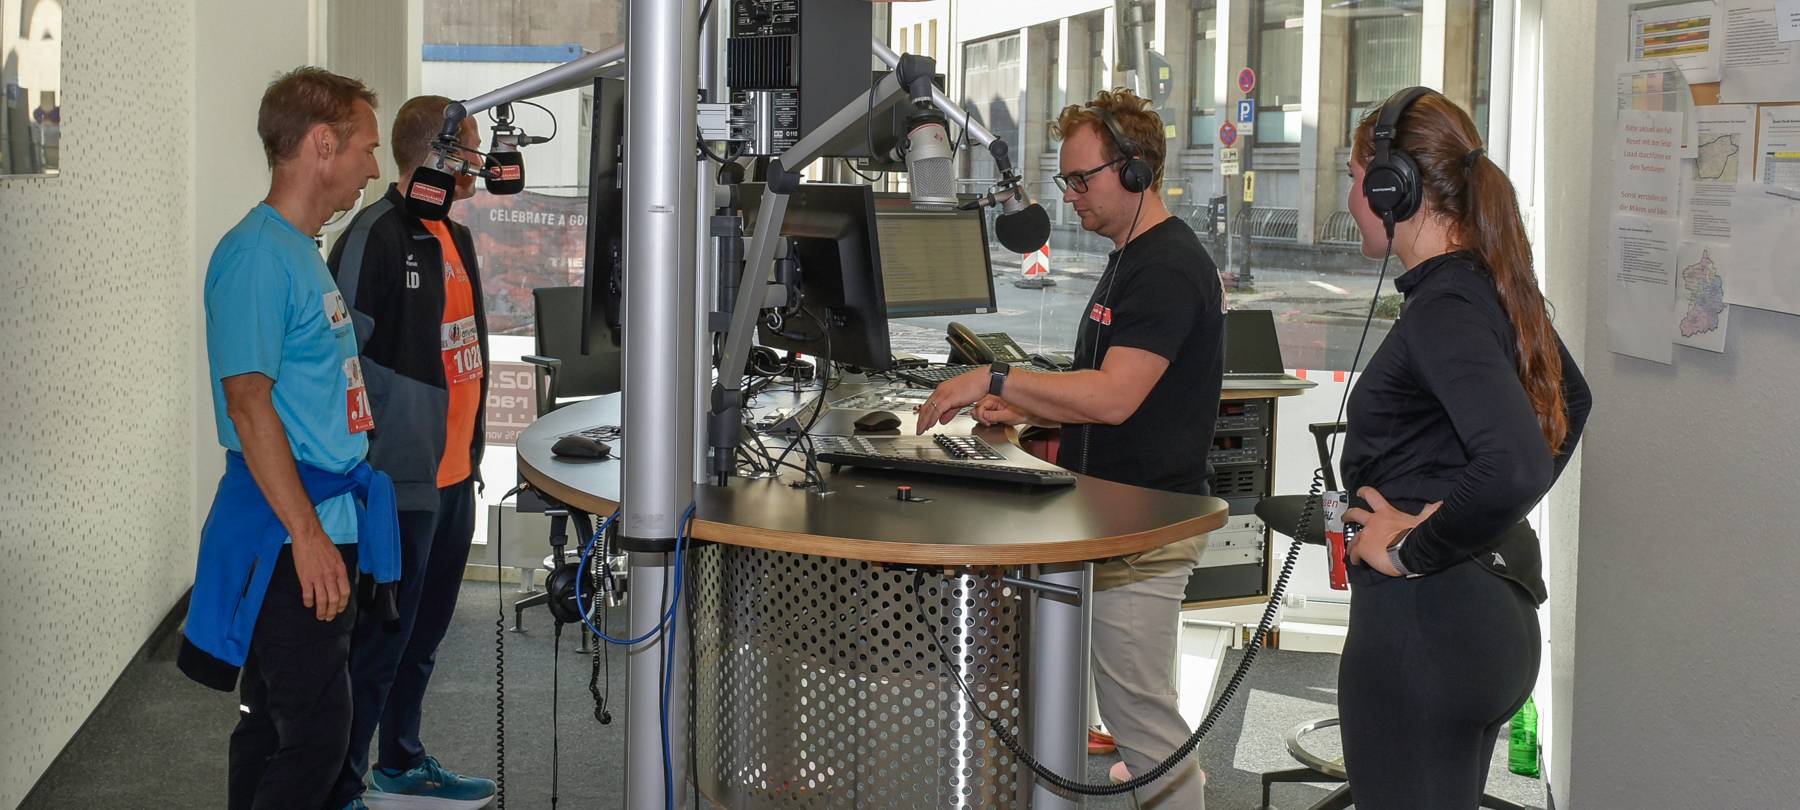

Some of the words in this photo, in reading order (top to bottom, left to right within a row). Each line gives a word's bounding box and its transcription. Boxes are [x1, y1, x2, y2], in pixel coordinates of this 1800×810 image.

[1241, 102, 1250, 122] P
[490, 209, 555, 225] CELEBRATE
[558, 214, 565, 226] A
